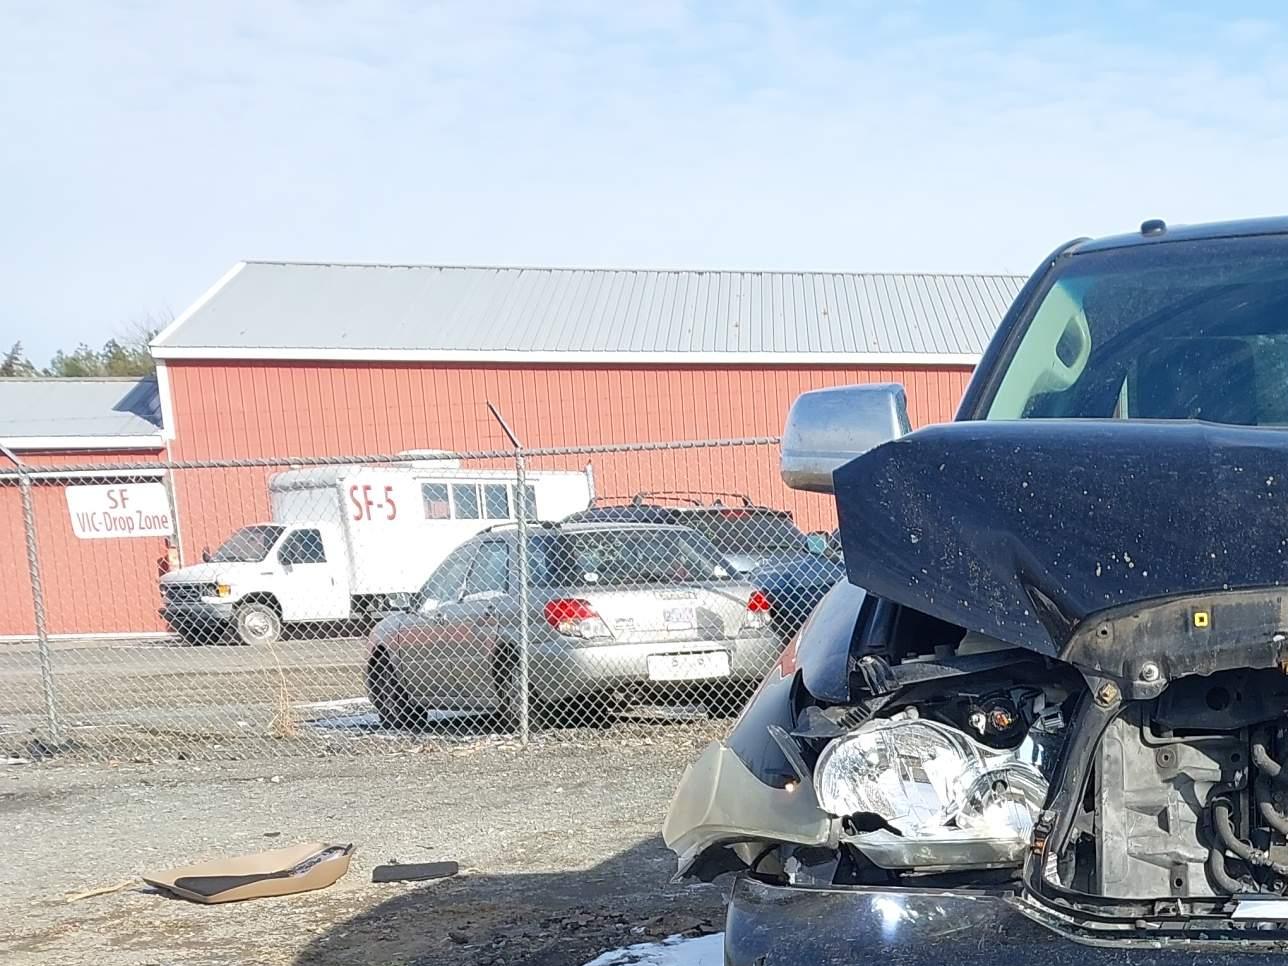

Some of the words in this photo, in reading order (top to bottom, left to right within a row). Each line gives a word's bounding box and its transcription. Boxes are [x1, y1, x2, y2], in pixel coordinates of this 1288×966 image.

[107, 489, 129, 509] SF
[350, 485, 396, 520] SF-5
[77, 511, 135, 533] VIC-Drop
[136, 510, 169, 530] Zone
